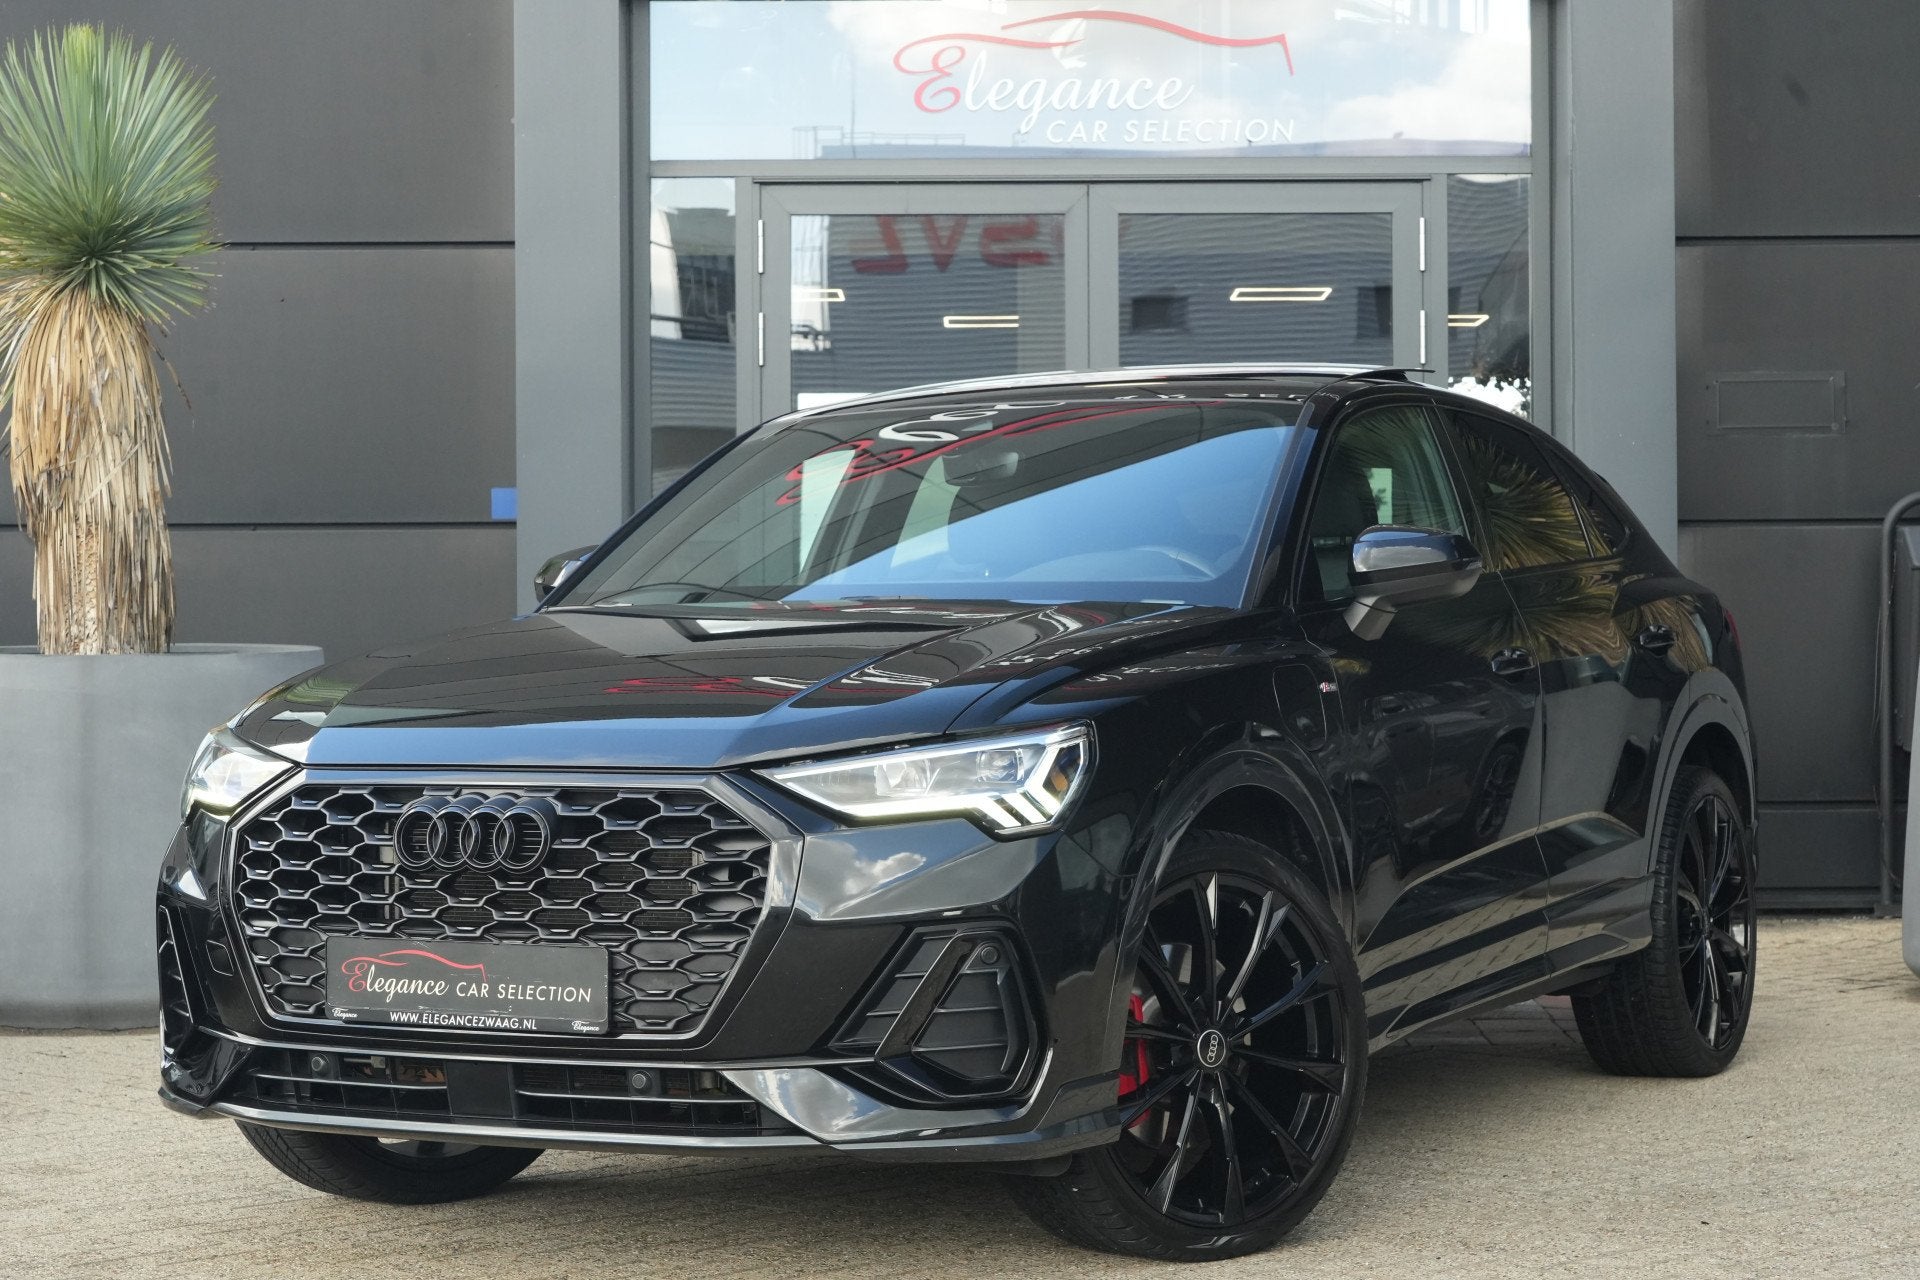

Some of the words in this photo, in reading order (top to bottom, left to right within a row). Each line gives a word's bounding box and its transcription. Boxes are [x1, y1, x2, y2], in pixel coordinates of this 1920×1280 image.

[893, 34, 1195, 134] Elegance
[1046, 120, 1107, 144] CAR
[1124, 119, 1295, 144] SELECTION
[342, 957, 449, 1002] Elegance
[456, 982, 489, 998] CAR
[497, 983, 592, 1003] SELECTION
[389, 1011, 537, 1030] WWW.ELEGANCEZWAAG.NL
